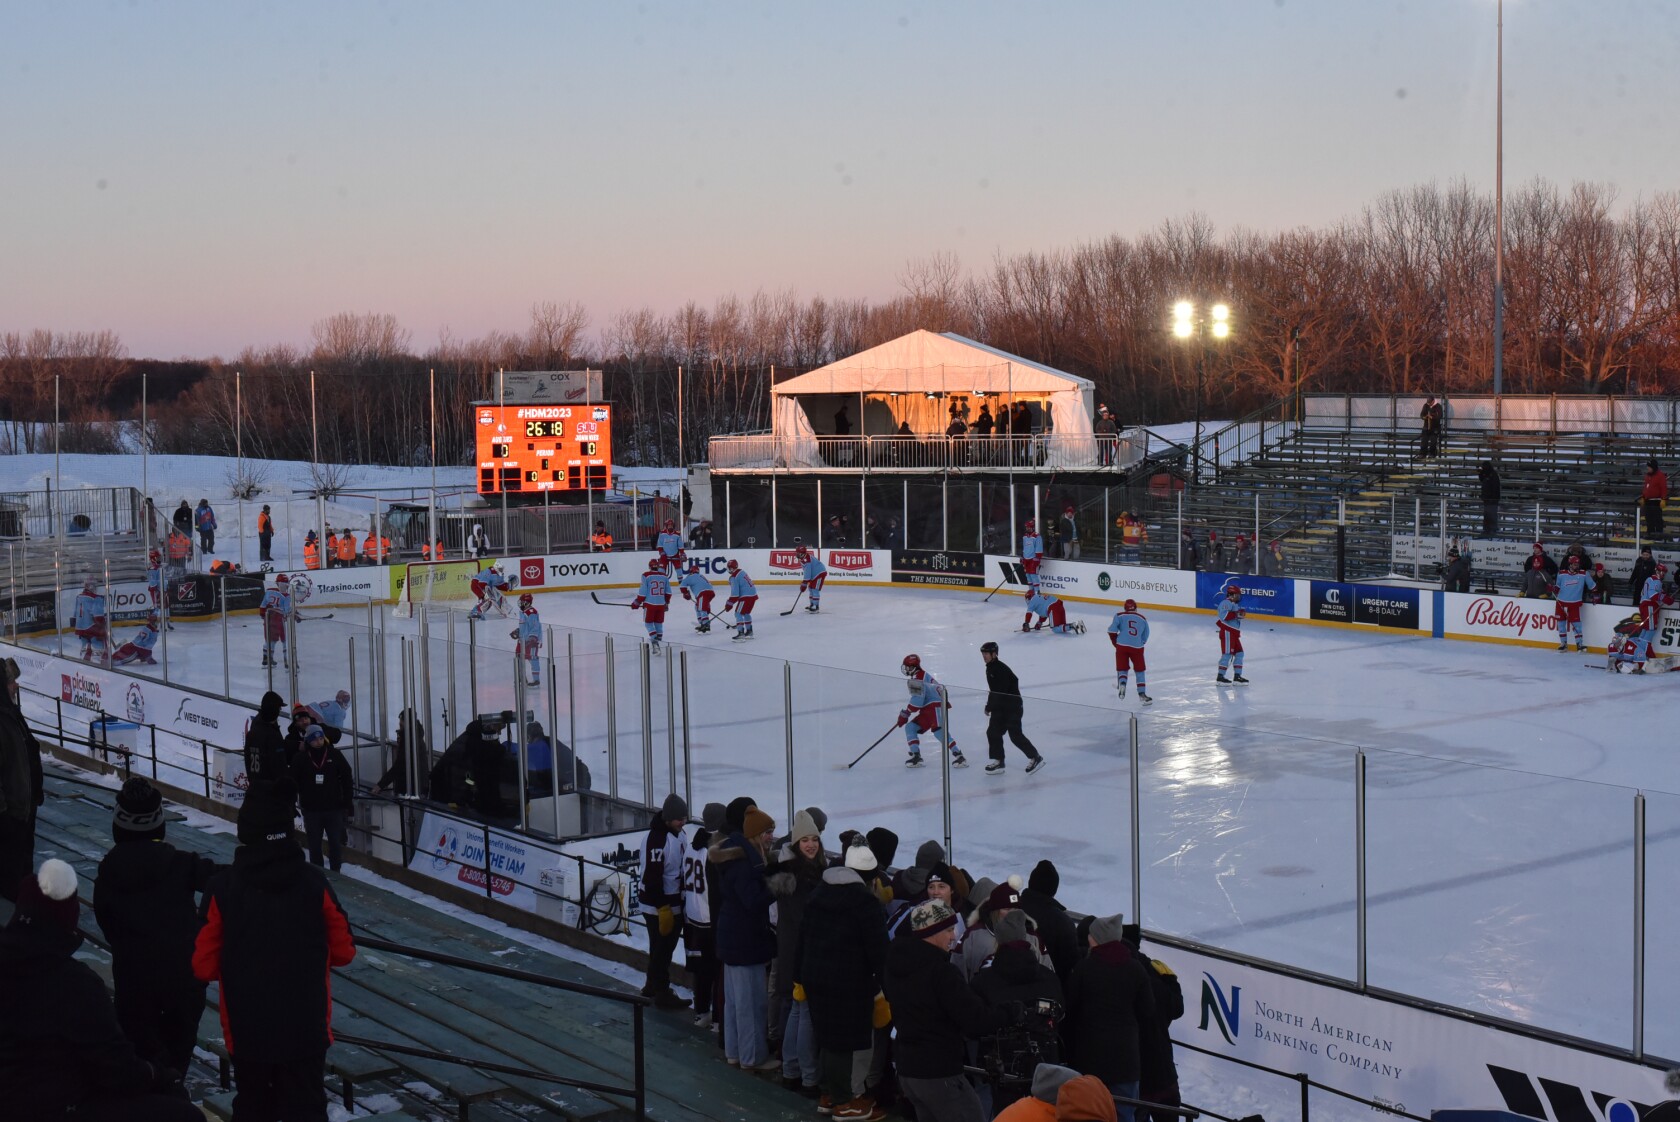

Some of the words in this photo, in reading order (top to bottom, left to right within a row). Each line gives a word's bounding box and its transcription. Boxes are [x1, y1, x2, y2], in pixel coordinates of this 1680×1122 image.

[518, 408, 571, 418] #HDM2023
[527, 422, 562, 436] 26:18
[589, 442, 596, 455] 0
[531, 472, 537, 481] 0
[559, 470, 564, 480] 0
[776, 554, 800, 565] brya
[835, 554, 866, 567] bryant
[550, 563, 610, 577] TOYOTA
[926, 576, 969, 585] MINNESOTAN
[1040, 574, 1078, 583] WILSON
[651, 581, 665, 595] 22
[1115, 580, 1178, 593] LUNDS&BYERLYS
[1252, 588, 1274, 597] BEND
[1362, 598, 1389, 606] URGENT
[1390, 601, 1408, 609] CARE
[1382, 607, 1401, 616] DAILY
[1466, 598, 1530, 636] Bally
[1128, 620, 1138, 636] 5
[74, 694, 101, 710] delivery
[184, 712, 200, 723] WEST
[201, 716, 218, 729] BEND
[250, 754, 260, 772] 26
[266, 832, 286, 840] QUINN
[466, 832, 484, 843] Unions
[488, 838, 504, 849] enefit
[504, 843, 525, 855] Workers
[461, 844, 484, 862] JOIN
[489, 852, 505, 868] THE
[506, 858, 525, 875] IAM
[650, 848, 663, 862] 17
[685, 858, 705, 894] 28
